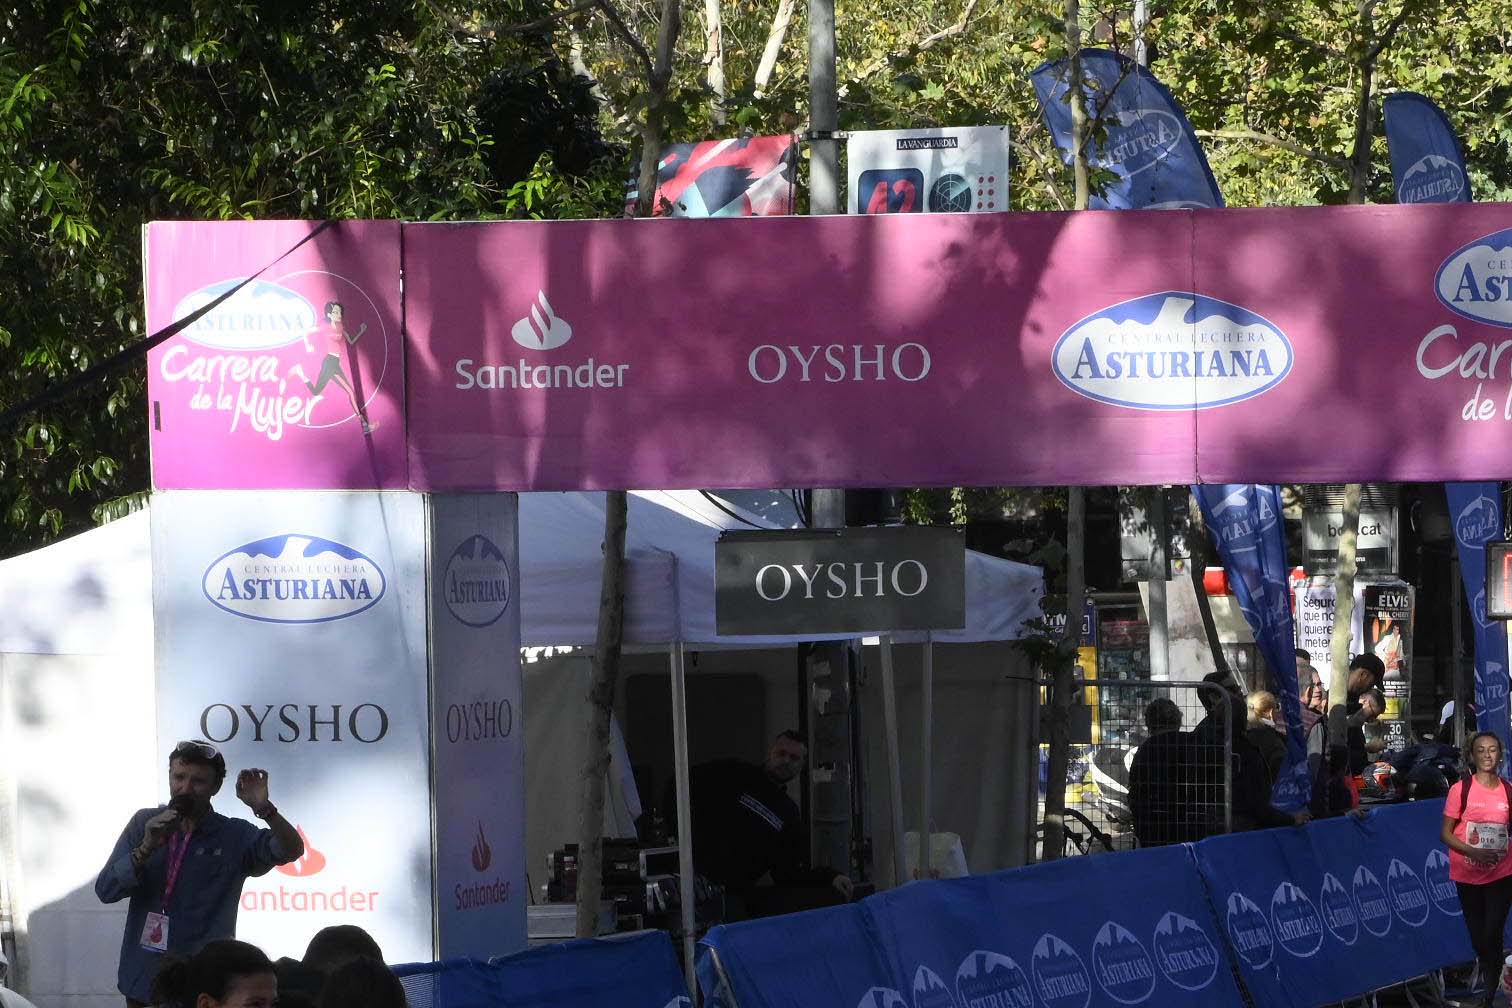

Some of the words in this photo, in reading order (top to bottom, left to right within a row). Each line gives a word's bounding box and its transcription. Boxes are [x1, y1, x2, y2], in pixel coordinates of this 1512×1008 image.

[907, 138, 957, 148] VANGUARDIA
[1109, 331, 1182, 346] CENTRAL
[1192, 331, 1266, 345] LECHERA
[160, 345, 282, 384] Carrera
[455, 357, 630, 390] Santander
[748, 342, 932, 384] OYSHO
[1071, 337, 1274, 381] ASTURIANA
[190, 383, 213, 412] de
[216, 383, 233, 412] la
[230, 372, 326, 441] Mujer
[1462, 382, 1497, 422] de
[217, 567, 373, 601] ASTURIANA
[245, 564, 302, 575] CENTRAL
[308, 564, 366, 574] LECHERA
[755, 560, 928, 600] OYSHO
[449, 570, 507, 604] ASTURIANA
[1379, 594, 1408, 607] ELVIS
[1304, 612, 1320, 622] que
[1310, 651, 1324, 661] ste
[199, 703, 389, 744] OYSHO
[447, 698, 512, 744] OYSHO
[1389, 725, 1402, 735] 30
[241, 887, 379, 912] antander
[455, 879, 512, 911] Santander
